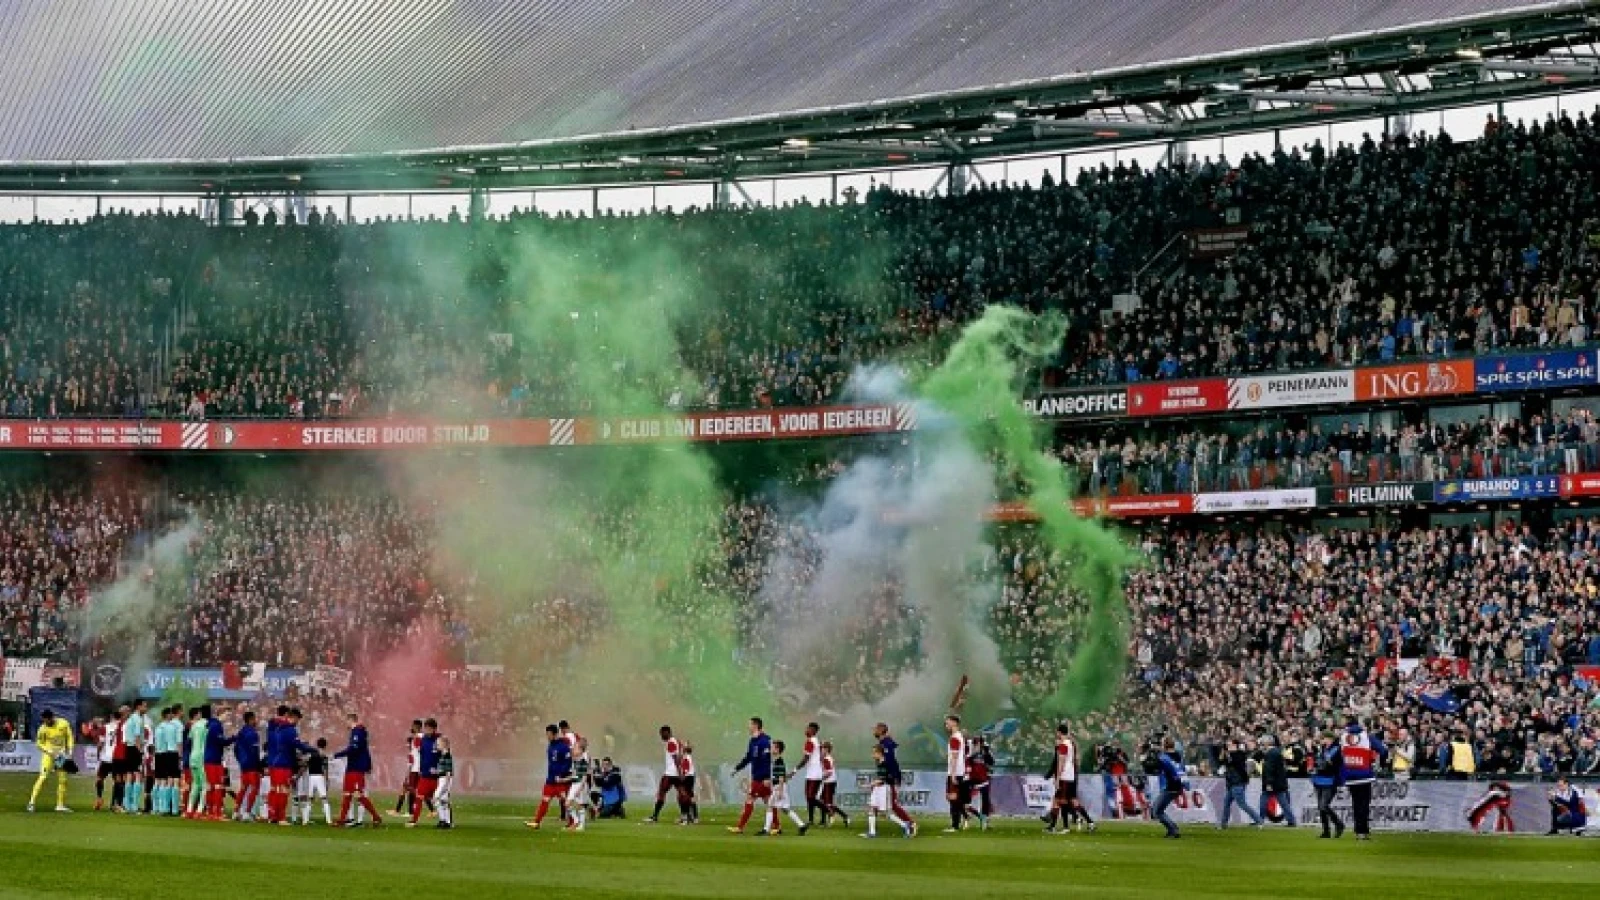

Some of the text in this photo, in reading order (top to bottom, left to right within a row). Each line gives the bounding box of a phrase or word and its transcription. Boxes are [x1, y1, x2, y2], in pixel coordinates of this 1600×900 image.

[1268, 376, 1348, 393] PEINEMANN
[1371, 372, 1419, 397] ING
[1477, 365, 1594, 386] SPIE SPIE SPIE
[620, 420, 660, 437] CLUB
[780, 412, 819, 431] VOOR
[823, 408, 891, 430] IEDEREEN
[302, 425, 489, 444] STERKER DOOR STRIJD
[1349, 484, 1415, 503] HELMINK
[1463, 479, 1519, 492] BURANDO
